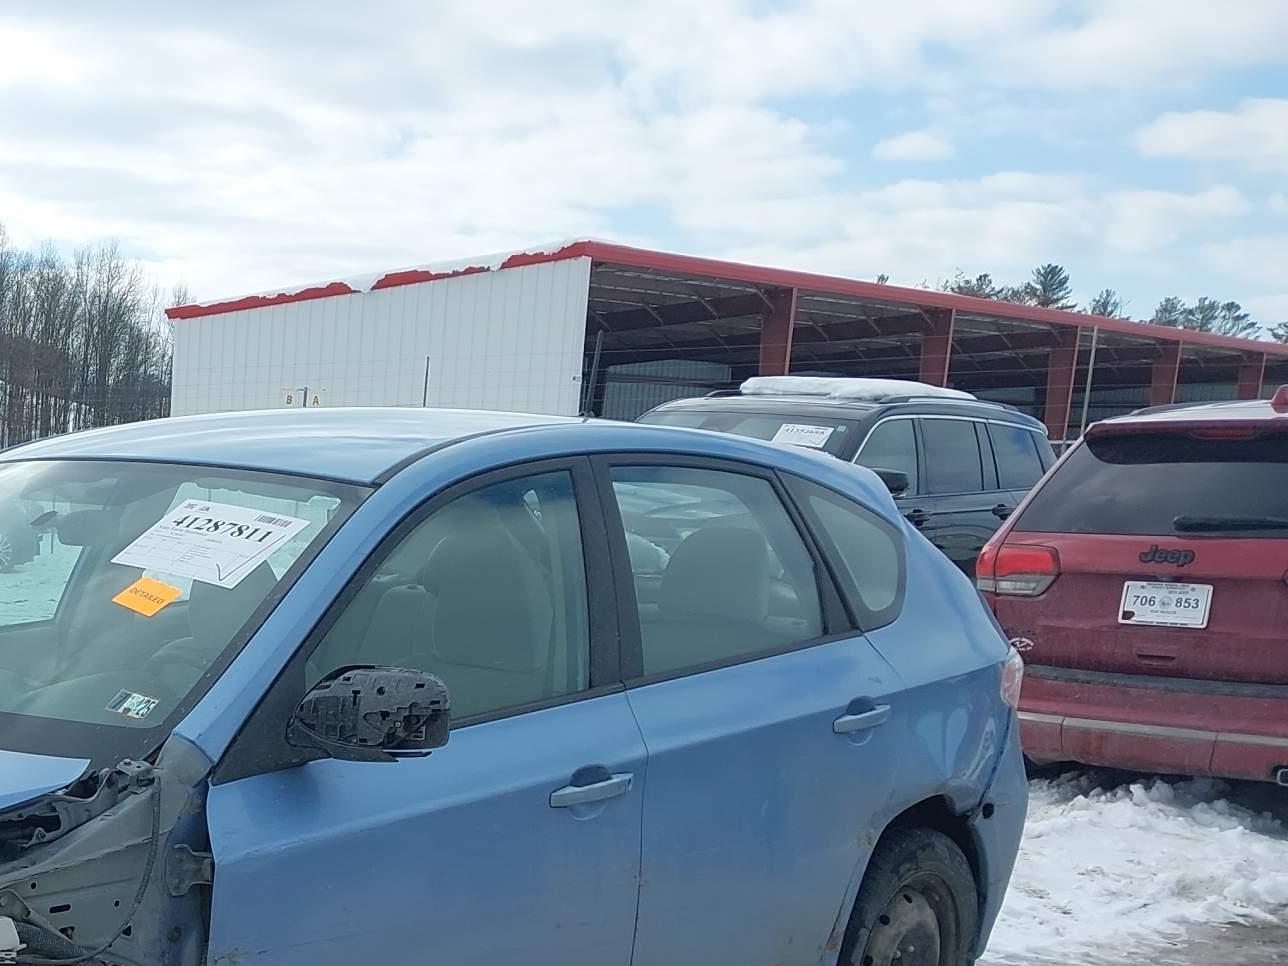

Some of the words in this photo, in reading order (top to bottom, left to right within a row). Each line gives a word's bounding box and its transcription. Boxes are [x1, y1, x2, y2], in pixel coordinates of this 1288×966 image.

[286, 395, 293, 405] B
[312, 396, 320, 406] A
[173, 514, 273, 544] 41287811
[1139, 544, 1195, 567] Jeep
[129, 586, 165, 605] DETAILED
[1132, 594, 1157, 607] 706
[1175, 597, 1200, 609] 853
[136, 699, 157, 718] 25
